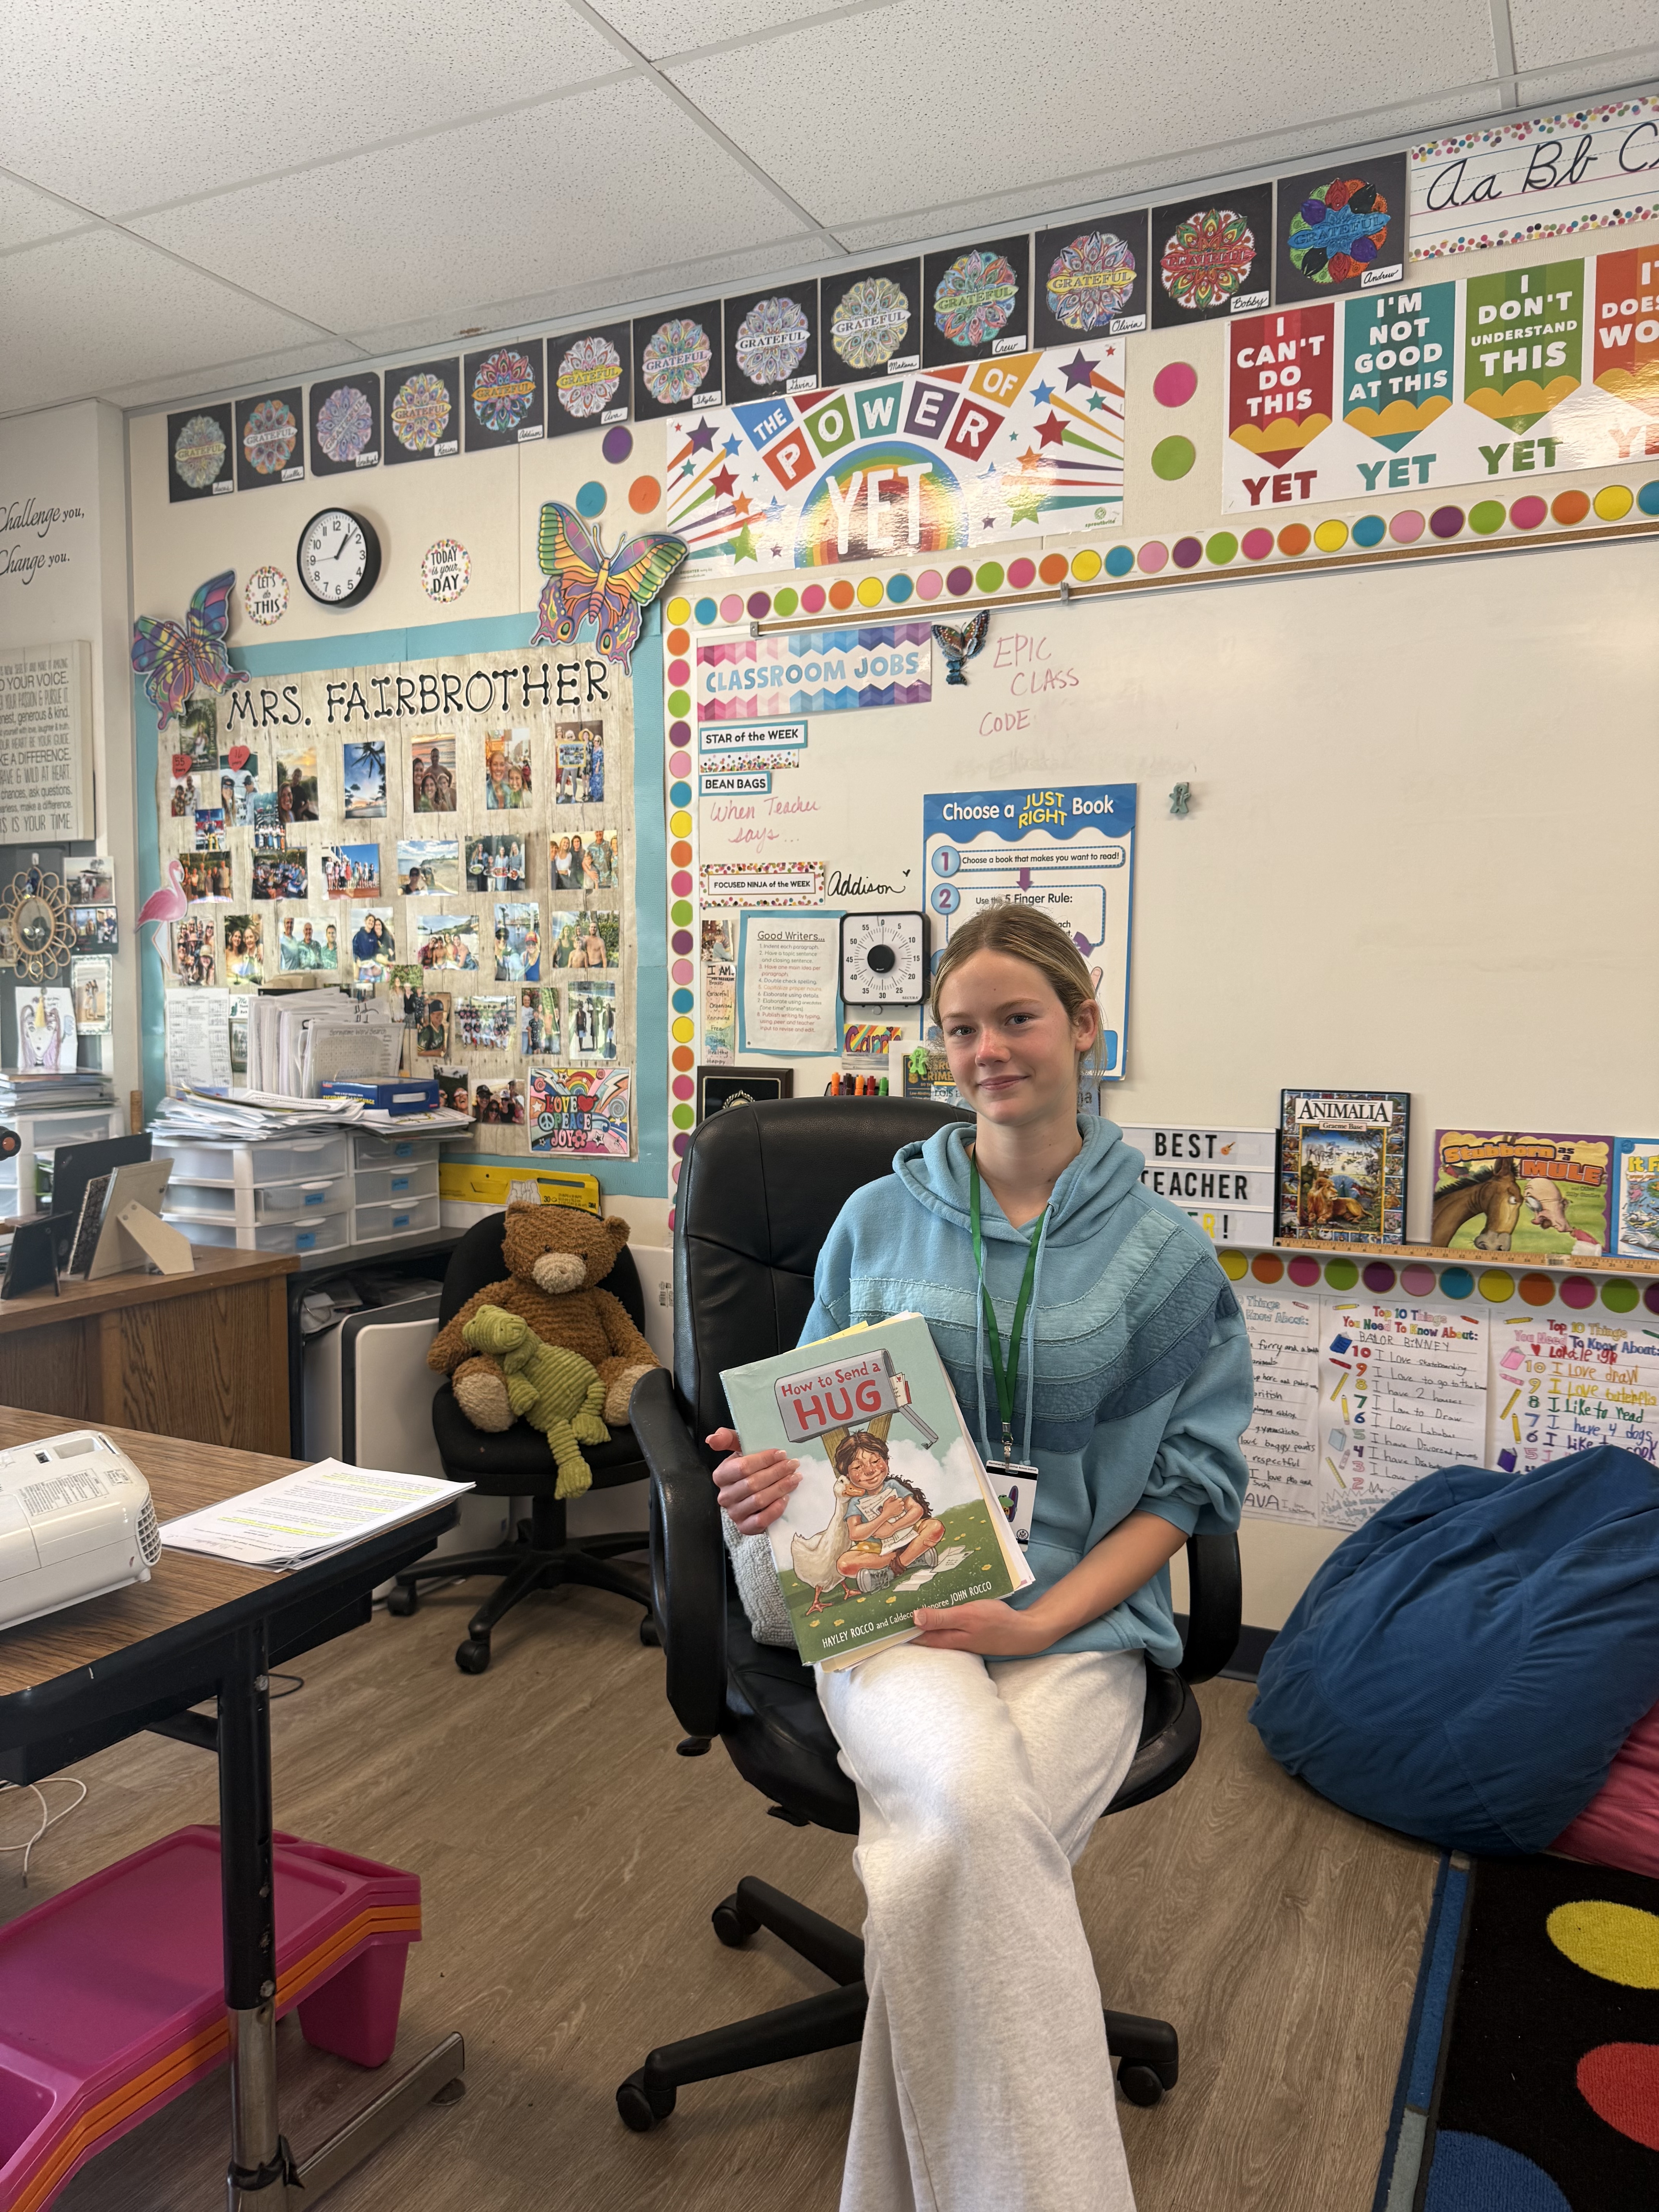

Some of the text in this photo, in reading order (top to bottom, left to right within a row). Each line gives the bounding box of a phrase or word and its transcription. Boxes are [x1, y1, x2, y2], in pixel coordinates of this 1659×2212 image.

[1522, 134, 1598, 192] Bb
[1295, 215, 1384, 244] GRATEFUL
[1053, 272, 1131, 288] GRATEFUL
[1364, 269, 1398, 283] Andrew
[1521, 275, 1528, 293] I
[1233, 297, 1267, 308] Bobby
[1377, 292, 1422, 318] I'M
[1479, 291, 1573, 324] DON'T
[836, 312, 905, 333] GRATEFUL
[1113, 319, 1142, 331] Olivia
[1277, 318, 1284, 337] I
[1370, 318, 1430, 345] NOT
[740, 332, 805, 349] GRATEFUL
[1472, 320, 1577, 346] UNDERSTAND
[995, 340, 1018, 353] Crew
[1237, 335, 1325, 368] CAN'T
[890, 360, 917, 371] Makana
[1355, 343, 1442, 373] GOOD
[1480, 341, 1566, 376] THIS
[790, 380, 813, 391] Gavin
[982, 366, 1018, 395] OF
[1259, 366, 1301, 390] DO
[1349, 370, 1448, 401] AT THIS
[695, 395, 718, 405] Skyla
[1247, 389, 1312, 417] THIS
[754, 407, 792, 441] THE
[519, 429, 542, 439] Addison
[783, 391, 991, 480] POWER
[1479, 437, 1563, 474] YET
[1356, 453, 1437, 491] YET
[1242, 470, 1317, 506] YET
[62, 508, 84, 522] you,
[826, 462, 933, 555] YET
[333, 521, 341, 531] 12
[313, 539, 321, 550] 10
[48, 553, 70, 567] you.
[360, 550, 366, 560] 3
[431, 547, 457, 565] TODAY
[432, 563, 458, 579] is your
[258, 573, 275, 589] LET'S
[336, 585, 341, 595] 6
[433, 574, 459, 593] DAY
[263, 590, 271, 599] do
[254, 599, 280, 614] THIS
[993, 633, 1052, 668] EPIC
[7, 671, 69, 690] YOUR VOICE.
[706, 652, 919, 693] CLASSROOM JOBS
[1010, 668, 1079, 696] CLASS
[226, 685, 312, 730] MRS.
[326, 659, 610, 723] FAIRBROTHER
[979, 709, 1030, 737] CODE
[706, 729, 798, 744] STAR of the WEEK
[18, 748, 71, 765] DIFFERENCE.
[706, 779, 766, 789] BEAN BAGS
[1023, 792, 1064, 810] JUST
[1072, 795, 1114, 815] Book
[710, 800, 755, 822] When
[943, 802, 1014, 820] Choose a
[1018, 808, 1067, 829] RIGHT
[24, 814, 46, 831] YOUR
[941, 852, 949, 871] 1
[1056, 854, 1069, 863] you
[939, 889, 951, 908] 2
[1014, 893, 1045, 905] Finger
[1048, 893, 1073, 903] Rule:
[758, 931, 782, 939] Good
[545, 1095, 578, 1113] LOVE
[1297, 1099, 1391, 1123] ANIMALIA
[554, 1113, 592, 1131] PEACE
[551, 1130, 574, 1148] JOY
[1154, 1132, 1217, 1159] BEST
[1444, 1144, 1575, 1163] Stubborn as
[1522, 1160, 1603, 1185] MULE
[1628, 1156, 1644, 1172] It
[1373, 1305, 1447, 1327] Top 10 Things
[1343, 1316, 1478, 1340] You Need To Know About:
[781, 1362, 881, 1397] How to Send a
[793, 1379, 882, 1431] HUG
[1252, 1455, 1299, 1467] respectful
[1244, 1493, 1279, 1510] AVA
[822, 1581, 992, 1648] HAYLEY ROCCO and JOHN ROCCO
